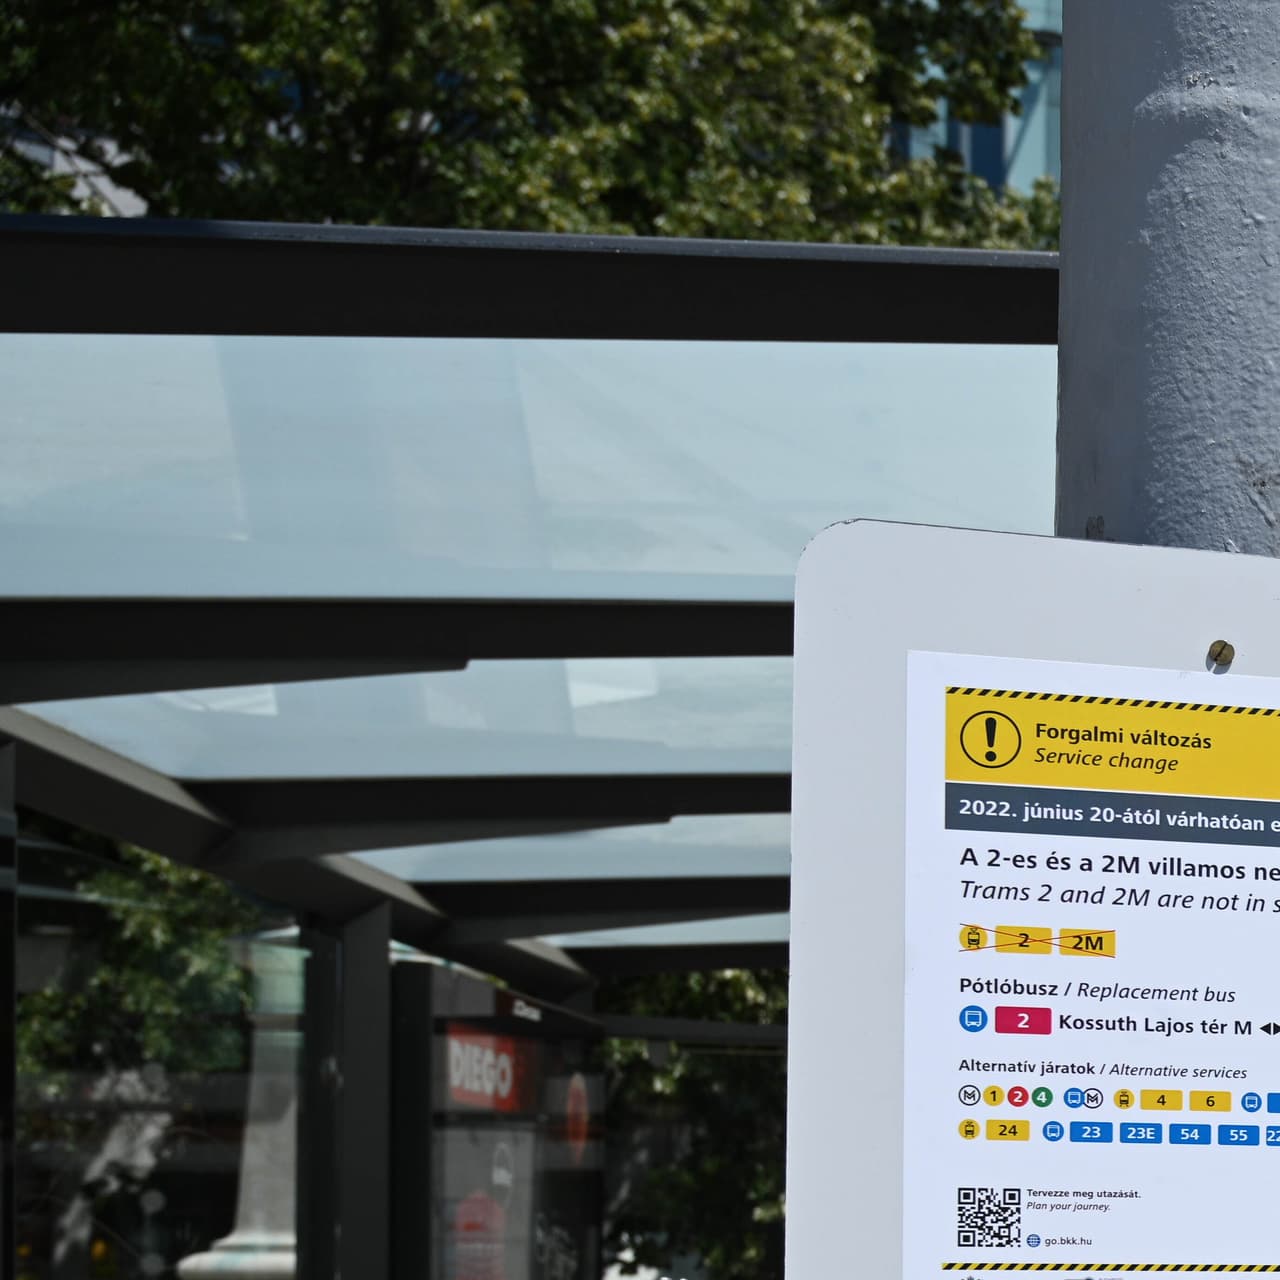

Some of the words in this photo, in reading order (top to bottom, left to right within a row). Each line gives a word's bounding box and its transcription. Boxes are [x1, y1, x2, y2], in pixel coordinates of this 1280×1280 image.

[1036, 723, 1123, 745] Forgalmi
[1130, 729, 1211, 749] változás
[1034, 748, 1103, 766] Service
[1109, 752, 1178, 774] change
[959, 799, 1017, 817] 2022.
[1022, 802, 1083, 822] június
[1090, 807, 1160, 825] 20-ától
[1166, 811, 1264, 831] várhatóan
[960, 848, 979, 866] A
[987, 849, 1037, 869] 2-es
[1046, 851, 1071, 871] és
[1079, 858, 1092, 872] a
[1102, 855, 1139, 874] 2M
[1148, 857, 1245, 879] villamos
[1018, 933, 1030, 947] 2
[1071, 933, 1103, 953] 2M
[960, 978, 1058, 996] Pótlóbusz
[1064, 982, 1072, 996] /
[1077, 982, 1199, 1002] Replacement
[1204, 986, 1236, 1002] bus
[1018, 1013, 1029, 1028] 2
[1059, 1015, 1137, 1031] Kossuth
[1145, 1017, 1194, 1037] Lajos
[1200, 1019, 1228, 1034] tér
[1234, 1020, 1251, 1035] M
[449, 1039, 513, 1098] DIEGO
[959, 1059, 1036, 1073] Alternatív
[1040, 1061, 1095, 1077] járatok
[1100, 1064, 1106, 1075] /
[1109, 1063, 1188, 1077] Alternative
[1192, 1066, 1247, 1079] services
[990, 1090, 996, 1101] 1
[1013, 1091, 1023, 1103] 2
[1036, 1091, 1047, 1103] 4
[1157, 1095, 1166, 1105] 4
[1206, 1096, 1215, 1107] 6
[999, 1124, 1018, 1136] 24
[1082, 1126, 1101, 1138] 23
[1127, 1127, 1155, 1139] 23E
[1181, 1128, 1200, 1140] 54
[1230, 1129, 1248, 1141] 55
[1026, 1189, 1070, 1197] Tervezze
[1072, 1191, 1094, 1200] meg
[1097, 1190, 1141, 1198] utazását.
[1026, 1201, 1047, 1210] Plan
[1049, 1204, 1072, 1212] your
[1073, 1204, 1109, 1213] journey.
[1045, 1237, 1092, 1247] go.bkk.hu
